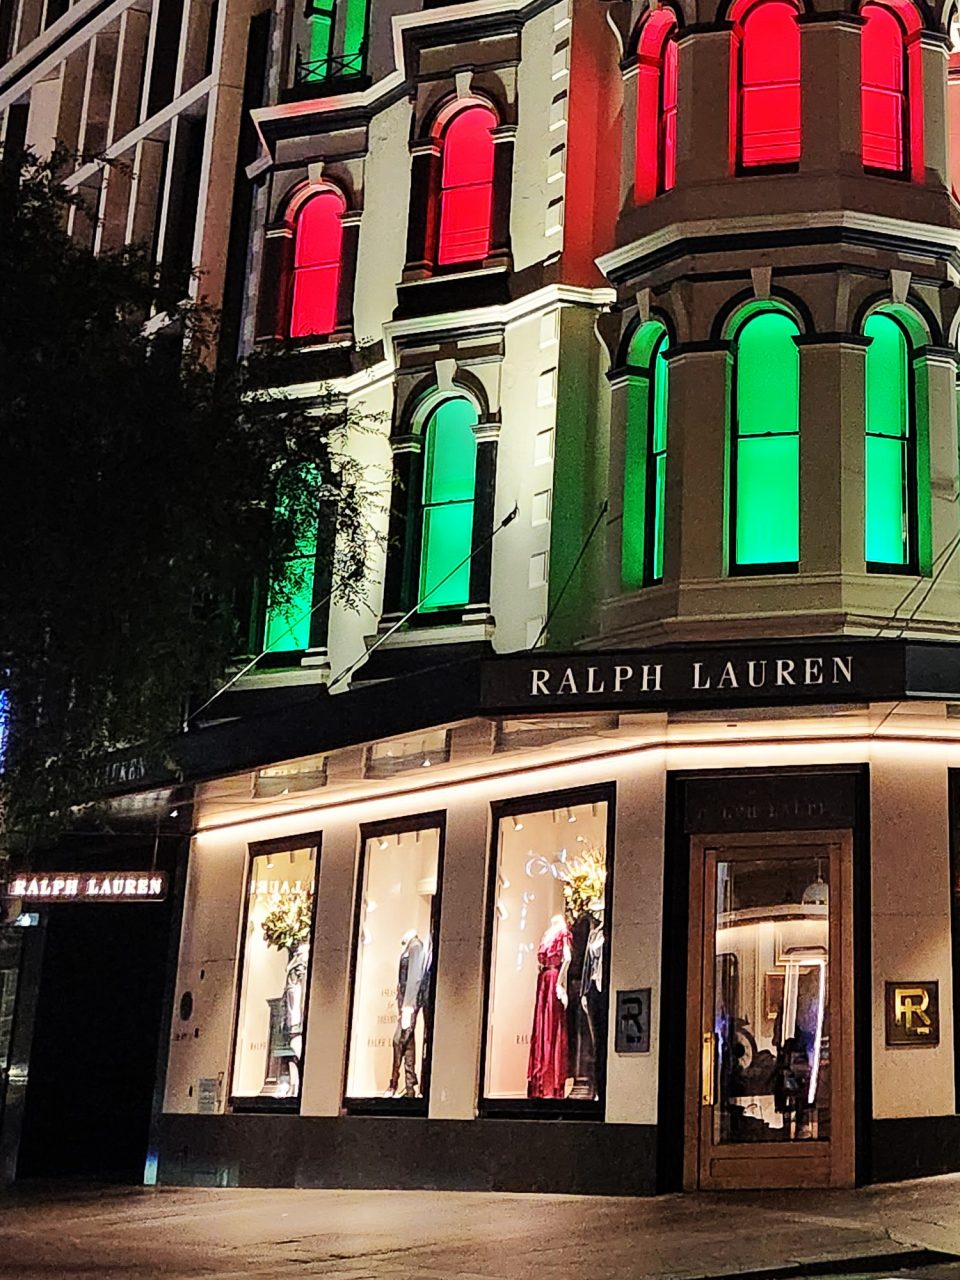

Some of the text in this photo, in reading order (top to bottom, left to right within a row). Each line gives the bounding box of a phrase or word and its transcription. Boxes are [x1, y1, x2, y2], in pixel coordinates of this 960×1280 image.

[531, 656, 854, 695] RALPH LAUREN
[9, 878, 163, 896] RALPH LAUREN
